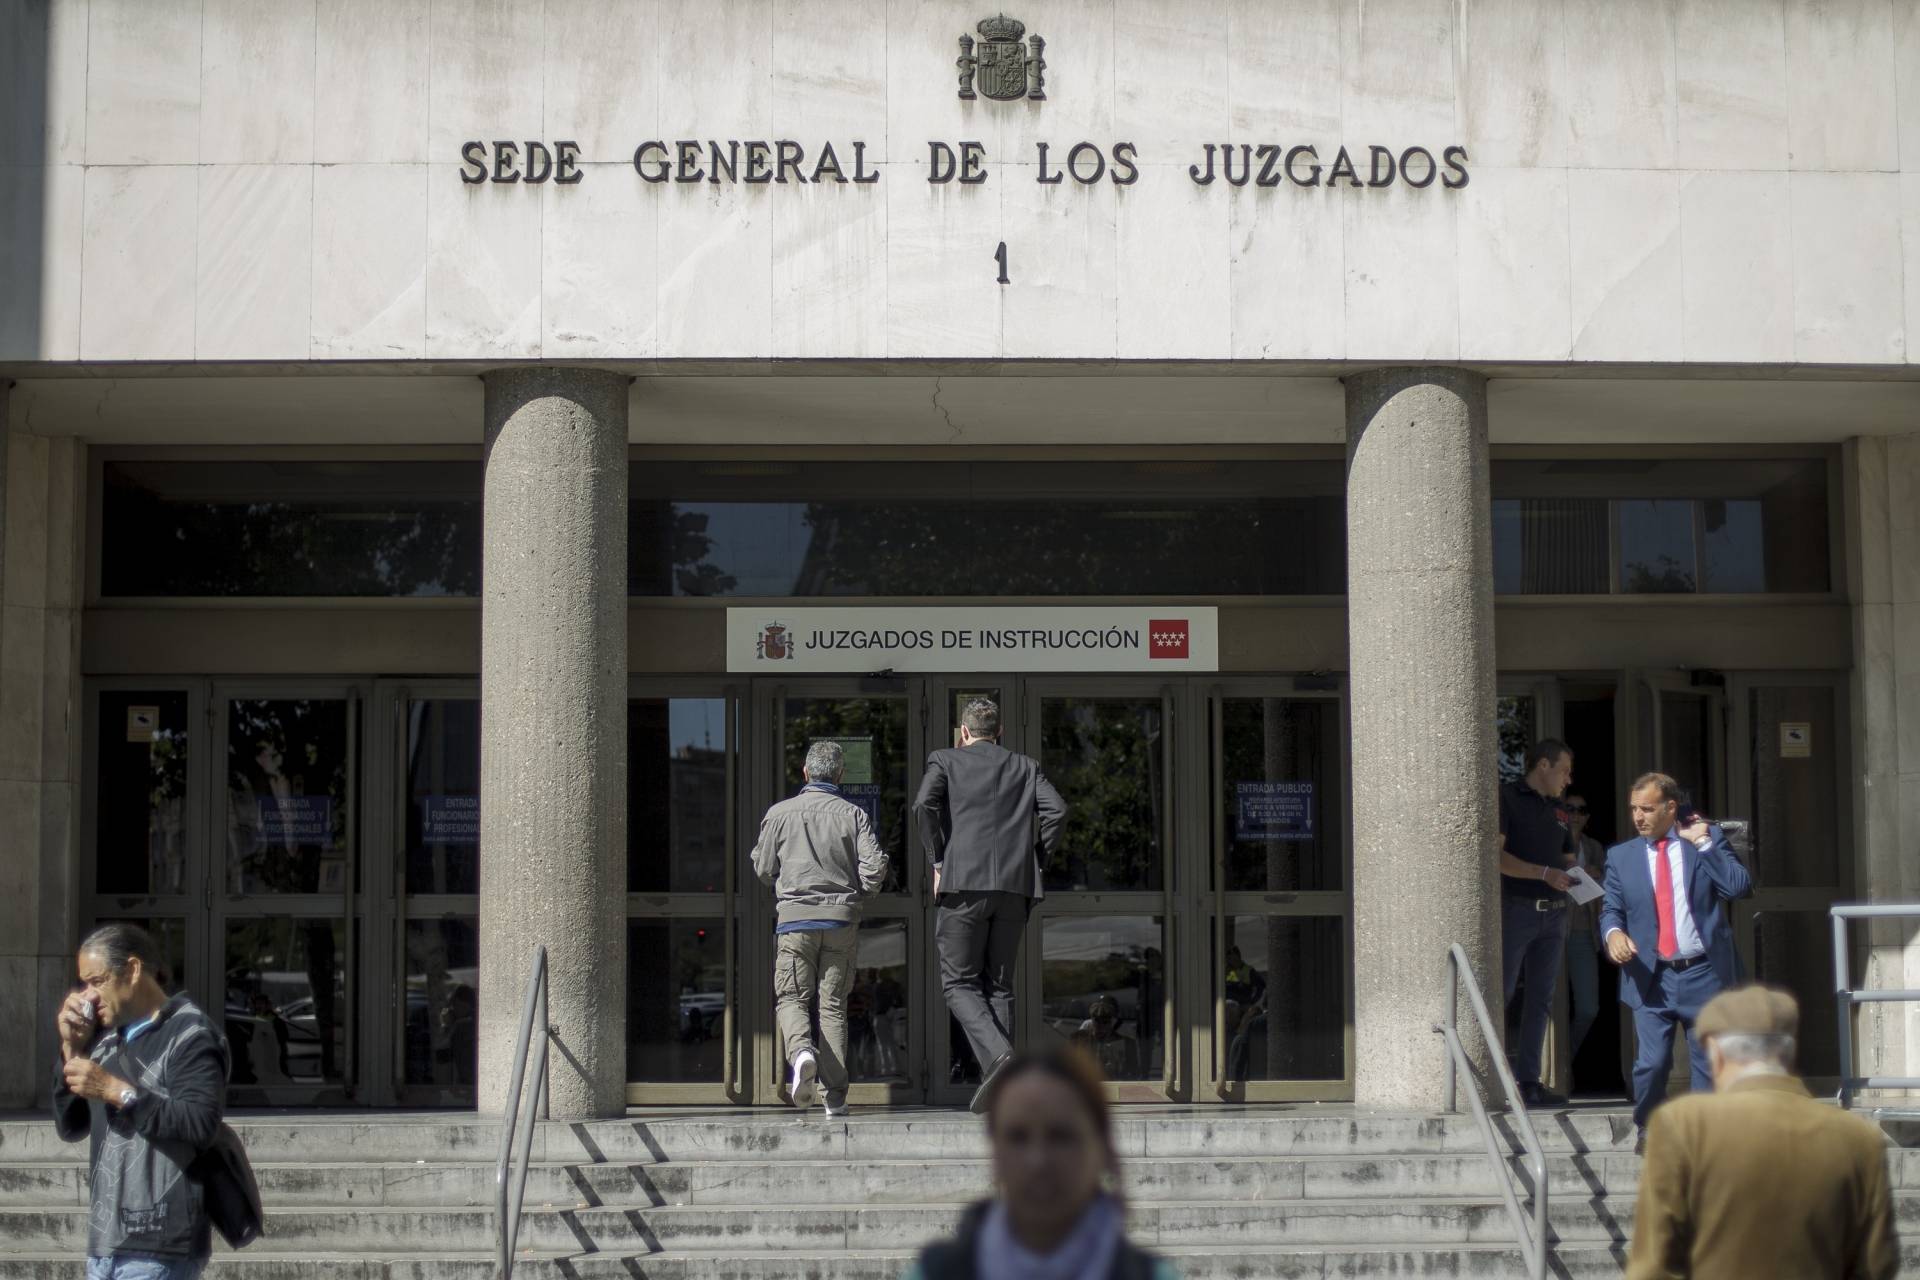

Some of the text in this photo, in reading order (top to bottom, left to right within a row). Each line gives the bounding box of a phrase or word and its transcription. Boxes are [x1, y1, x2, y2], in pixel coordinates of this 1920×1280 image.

[460, 140, 1469, 189] SEDE GENERAL DE LOS JUZGADOS
[994, 241, 1011, 285] 1
[805, 626, 1139, 650] JUZGADOS DE INSTRUCCIÓN
[1237, 783, 1313, 793] ENTRADA PUBLICO
[278, 798, 310, 809] ENTRADA
[445, 797, 477, 808] ENTRADA
[431, 810, 479, 821] FUNCIONARIO
[433, 823, 479, 833] PROFESIONAL
